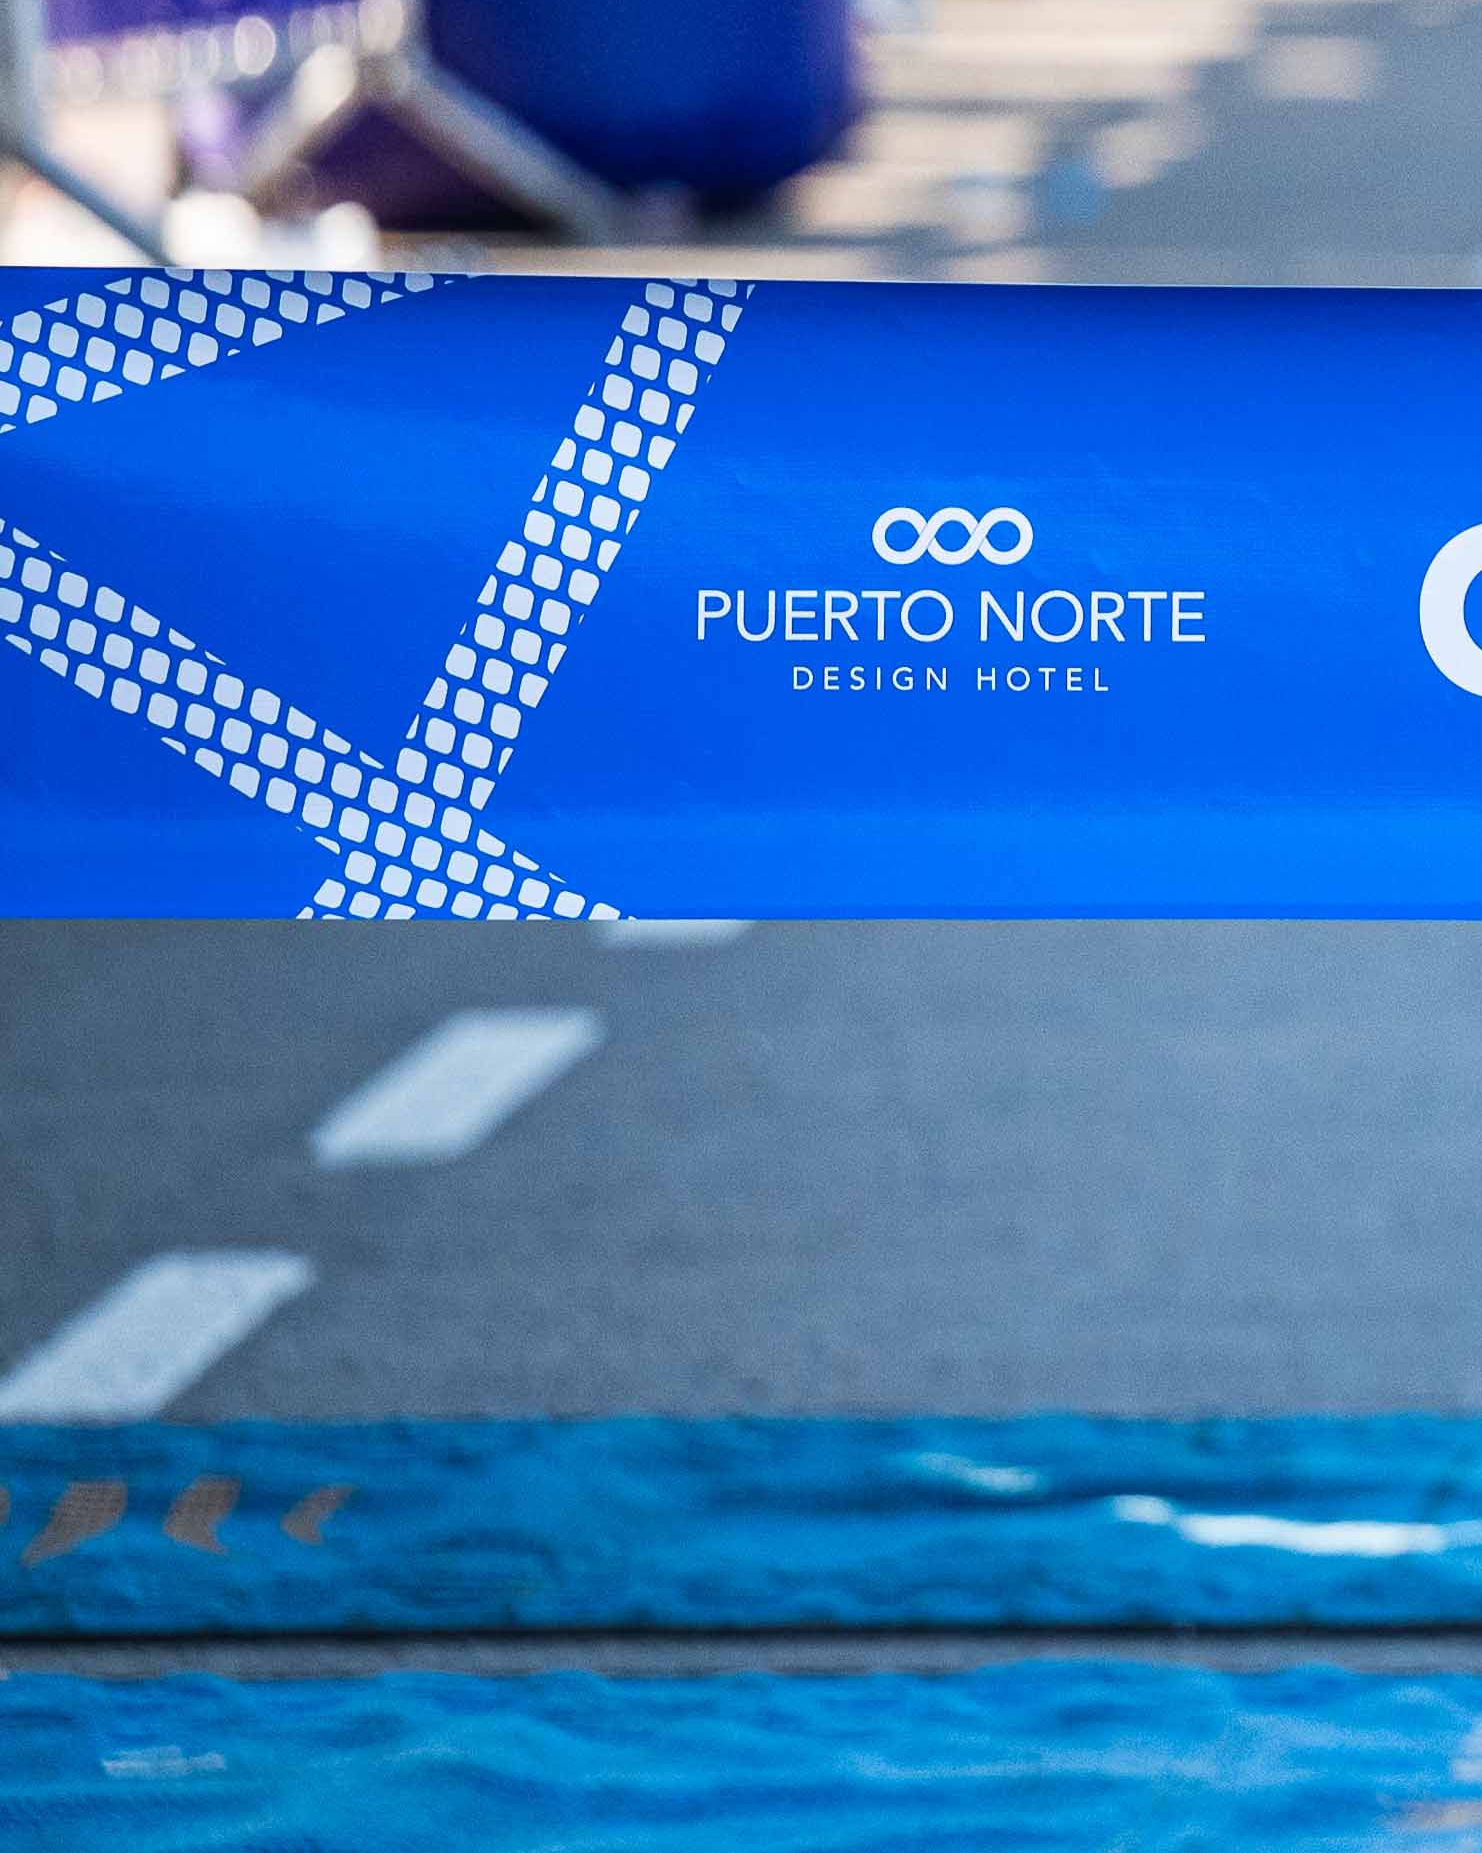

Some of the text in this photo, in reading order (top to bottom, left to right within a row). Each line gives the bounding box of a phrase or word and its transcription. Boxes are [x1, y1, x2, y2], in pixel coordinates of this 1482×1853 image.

[698, 589, 1206, 643] PUERTO NORTE
[793, 667, 1109, 692] DESIGN HOTEL
